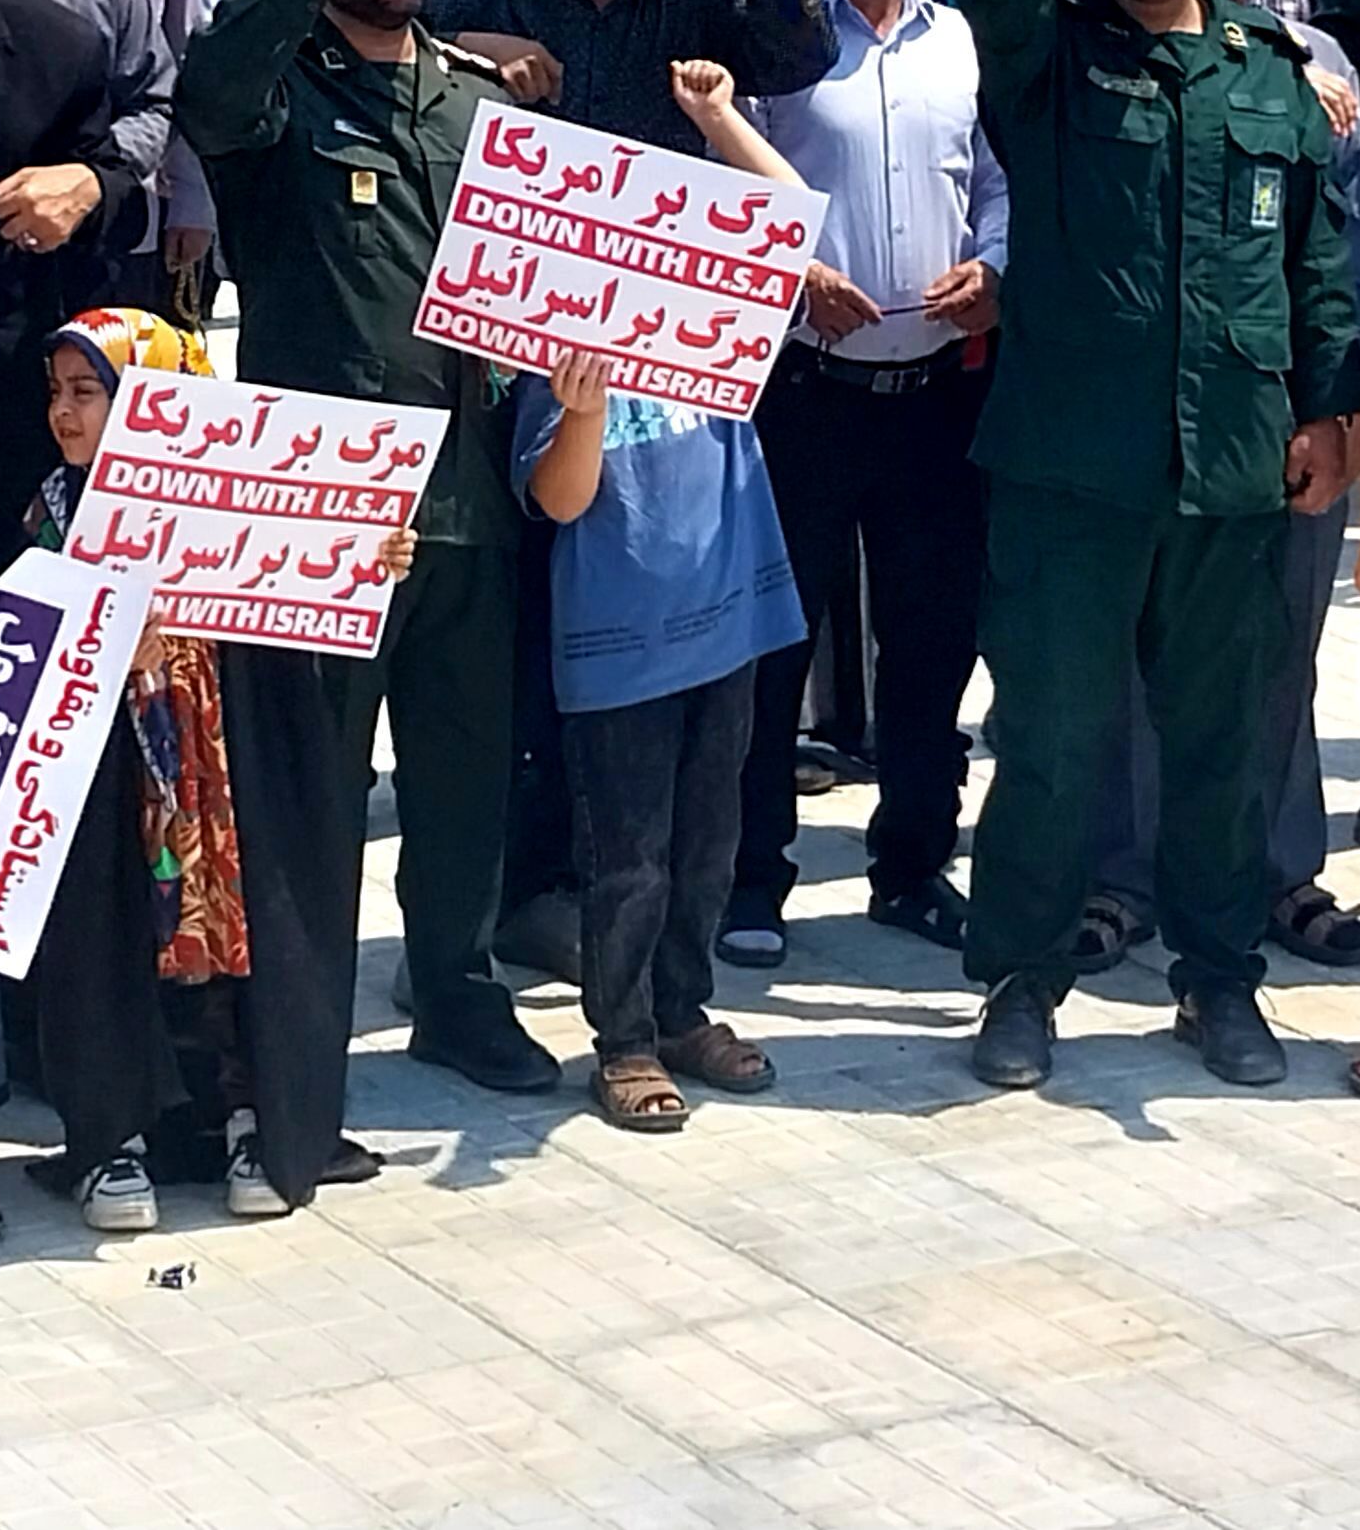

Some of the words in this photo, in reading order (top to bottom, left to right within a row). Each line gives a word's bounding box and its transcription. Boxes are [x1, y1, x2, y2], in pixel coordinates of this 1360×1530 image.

[481, 115, 644, 202] آمریکا
[634, 185, 688, 230] بر
[706, 192, 807, 257] مرگ
[465, 192, 584, 250] DOWN
[593, 227, 689, 280] WITH
[696, 258, 785, 303] U.S.A
[435, 241, 619, 326] اسرائیل
[424, 304, 540, 364] DOWN
[638, 362, 750, 412] ISRAEL
[611, 306, 666, 351] بر
[675, 309, 773, 370] مرگ
[125, 380, 282, 458] آمریکا
[271, 422, 322, 471] بر
[338, 419, 426, 482] مرگ
[104, 459, 221, 504] DOWN
[230, 480, 317, 516] WITH
[321, 492, 403, 522] U.S.A
[69, 506, 252, 584] اسرائیل
[237, 542, 290, 589] بر
[297, 534, 389, 600] مرگ
[174, 596, 260, 631] WITH
[264, 605, 375, 646] ISRAEL
[27, 730, 65, 760] و
[48, 585, 118, 731] مقاومت
